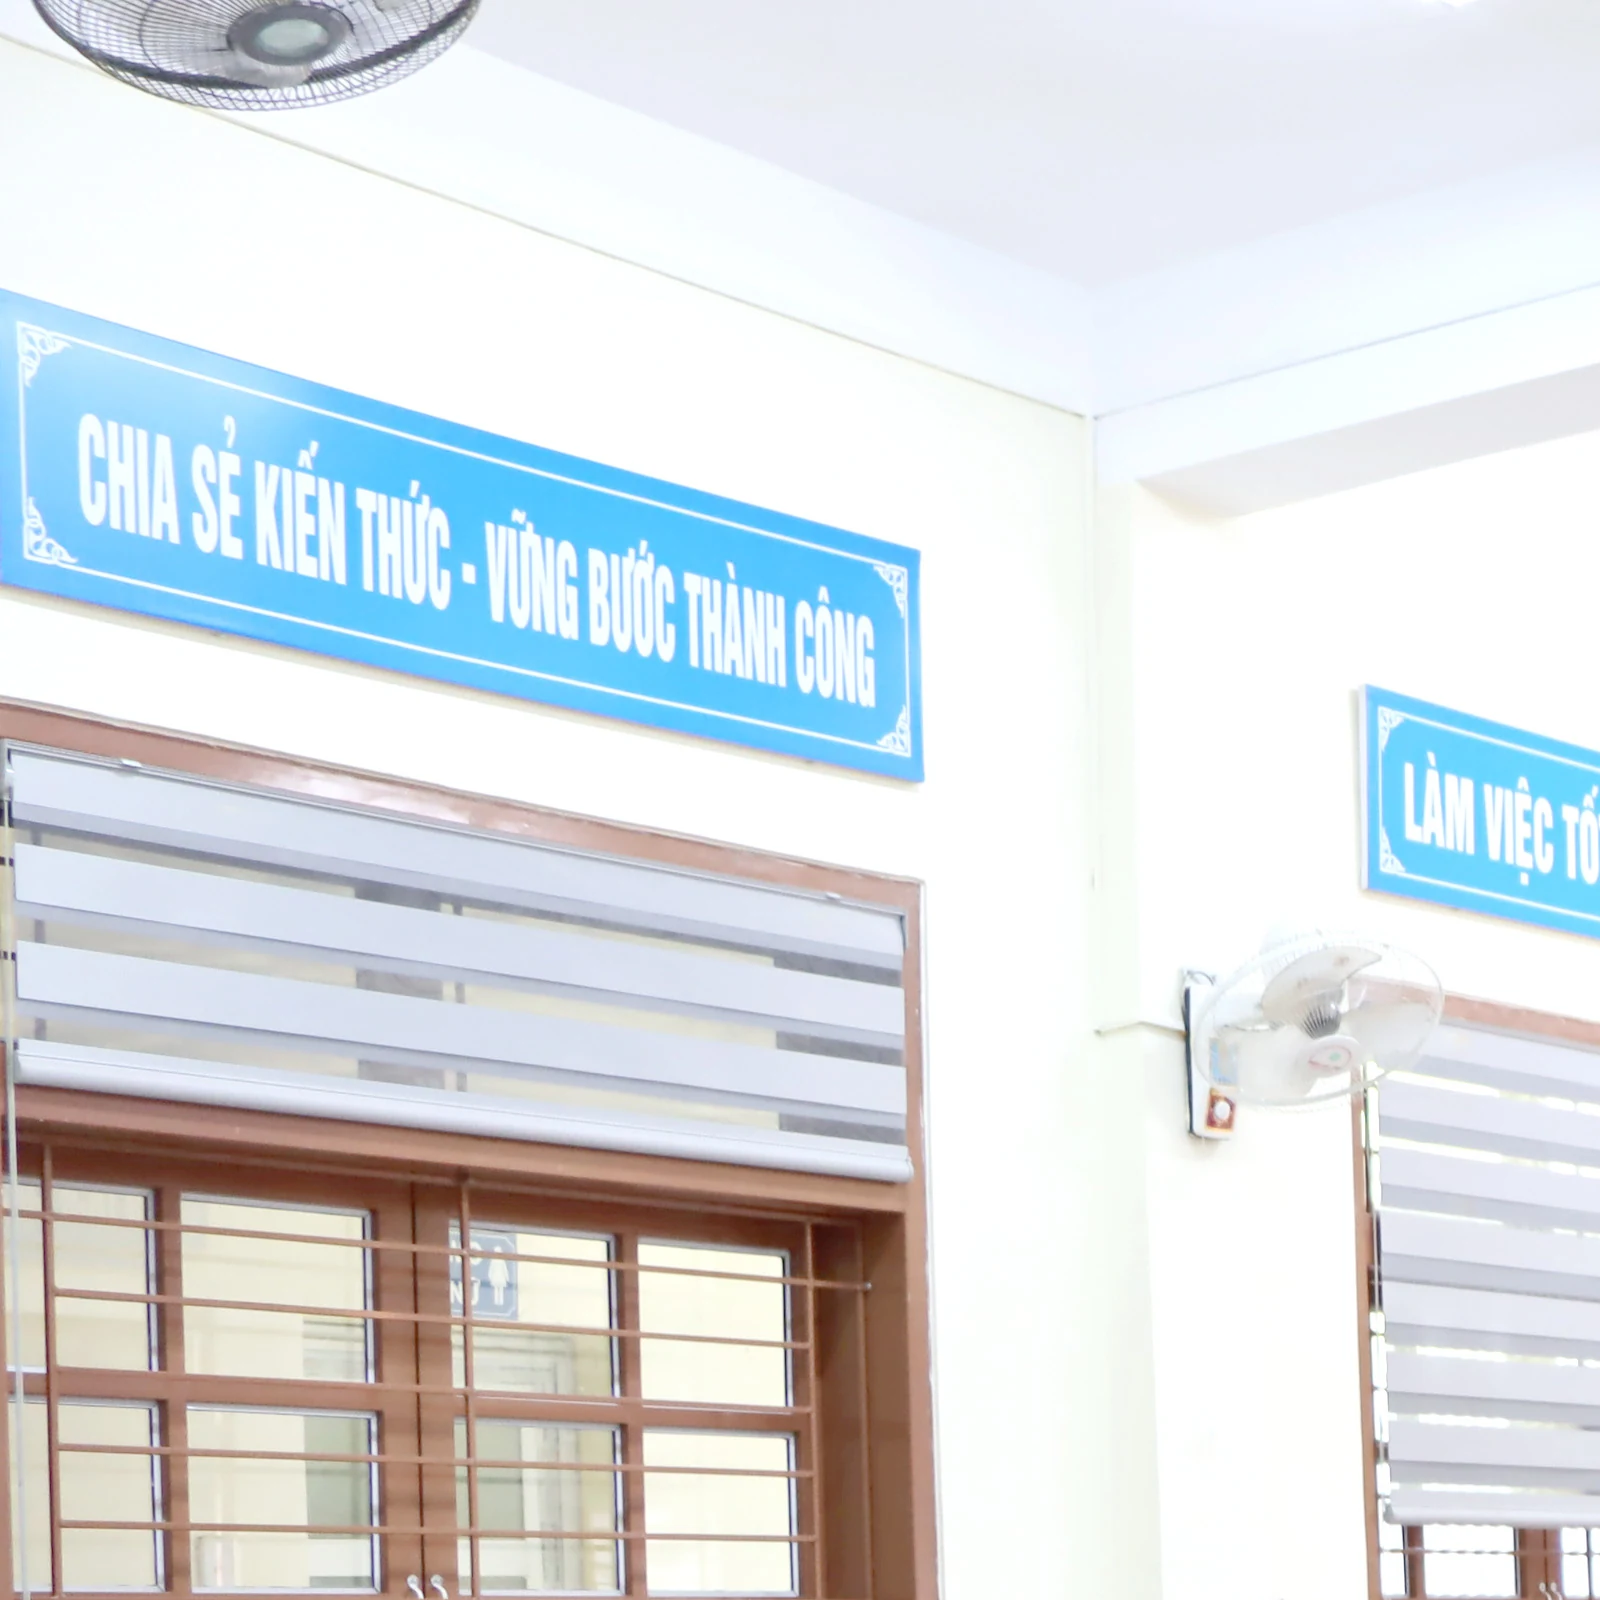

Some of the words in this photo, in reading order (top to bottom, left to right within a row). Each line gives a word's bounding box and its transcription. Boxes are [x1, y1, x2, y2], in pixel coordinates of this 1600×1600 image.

[77, 412, 181, 545] CHIA
[191, 415, 244, 561] SẺ
[254, 441, 347, 586] KIẾN
[356, 479, 452, 611] THỨC
[462, 564, 476, 584] -
[485, 508, 579, 641] VỮNG
[588, 538, 676, 664] BƯỚC
[684, 561, 787, 688] THÀNH
[794, 590, 876, 708] CÔNG
[1404, 751, 1475, 855] LÀM
[1484, 776, 1554, 886] VIỆC
